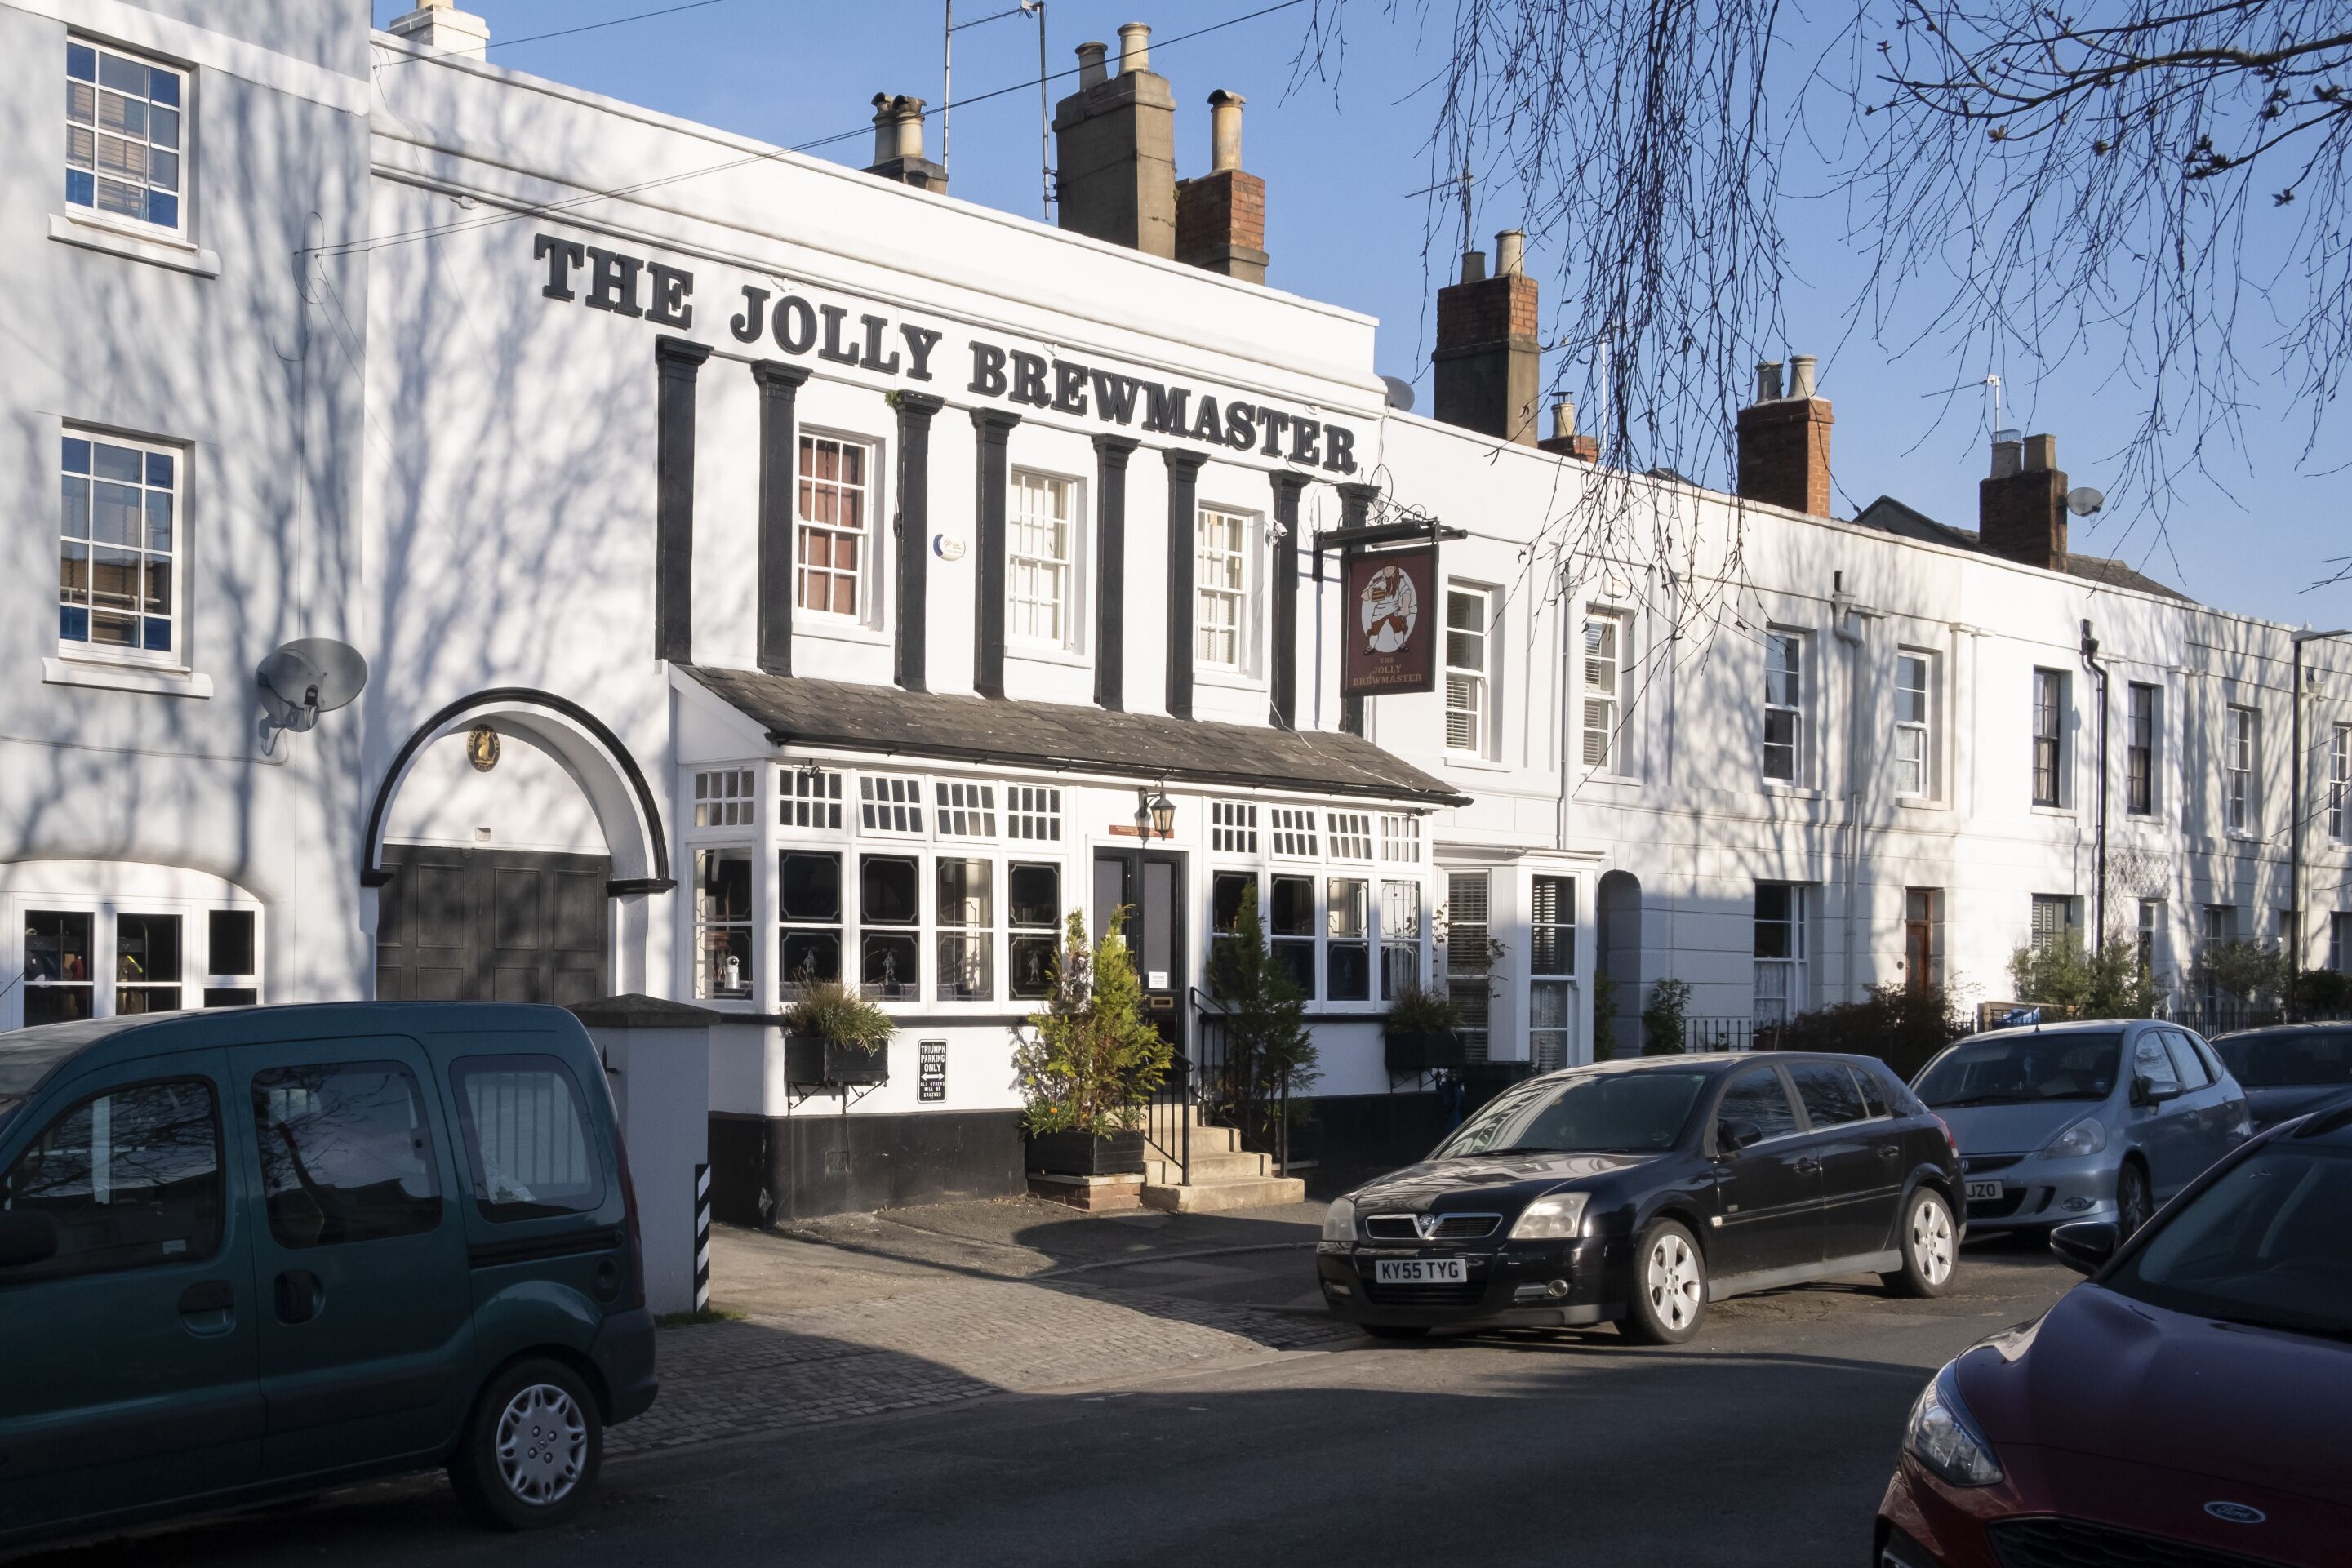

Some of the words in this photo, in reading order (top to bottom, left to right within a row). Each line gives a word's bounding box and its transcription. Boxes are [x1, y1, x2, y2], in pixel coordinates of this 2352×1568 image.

[534, 233, 694, 330] THE
[729, 284, 943, 381] JOLLY
[967, 340, 1358, 476] BREWMASTER
[1372, 664, 1402, 674] JOLLY
[1353, 673, 1422, 686] BREWMASTER
[921, 1045, 946, 1054] TRIUMPH
[921, 1055, 945, 1063] PARKING
[924, 1063, 941, 1072] ONLY
[1382, 1262, 1422, 1279] KY55
[1426, 1261, 1459, 1279] TYG
